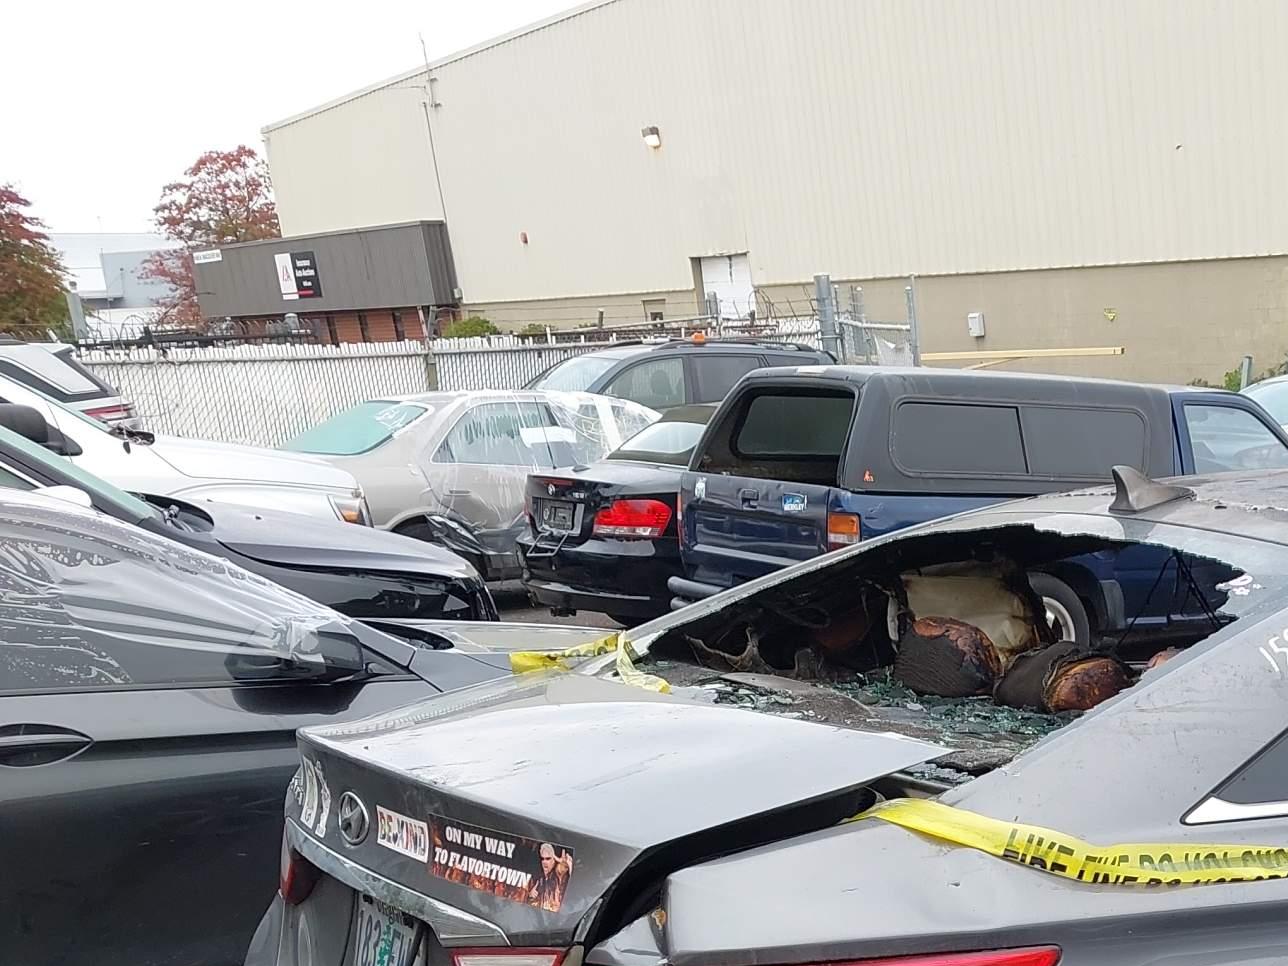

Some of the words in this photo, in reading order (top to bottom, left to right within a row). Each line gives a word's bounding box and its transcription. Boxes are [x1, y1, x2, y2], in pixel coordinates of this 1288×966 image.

[379, 810, 393, 843] BE
[397, 816, 426, 857] KIND
[445, 826, 462, 844] ON
[463, 830, 483, 850] MY
[484, 837, 516, 859] WAY
[434, 847, 449, 865] TO
[448, 852, 533, 889] FLAVORTOWN
